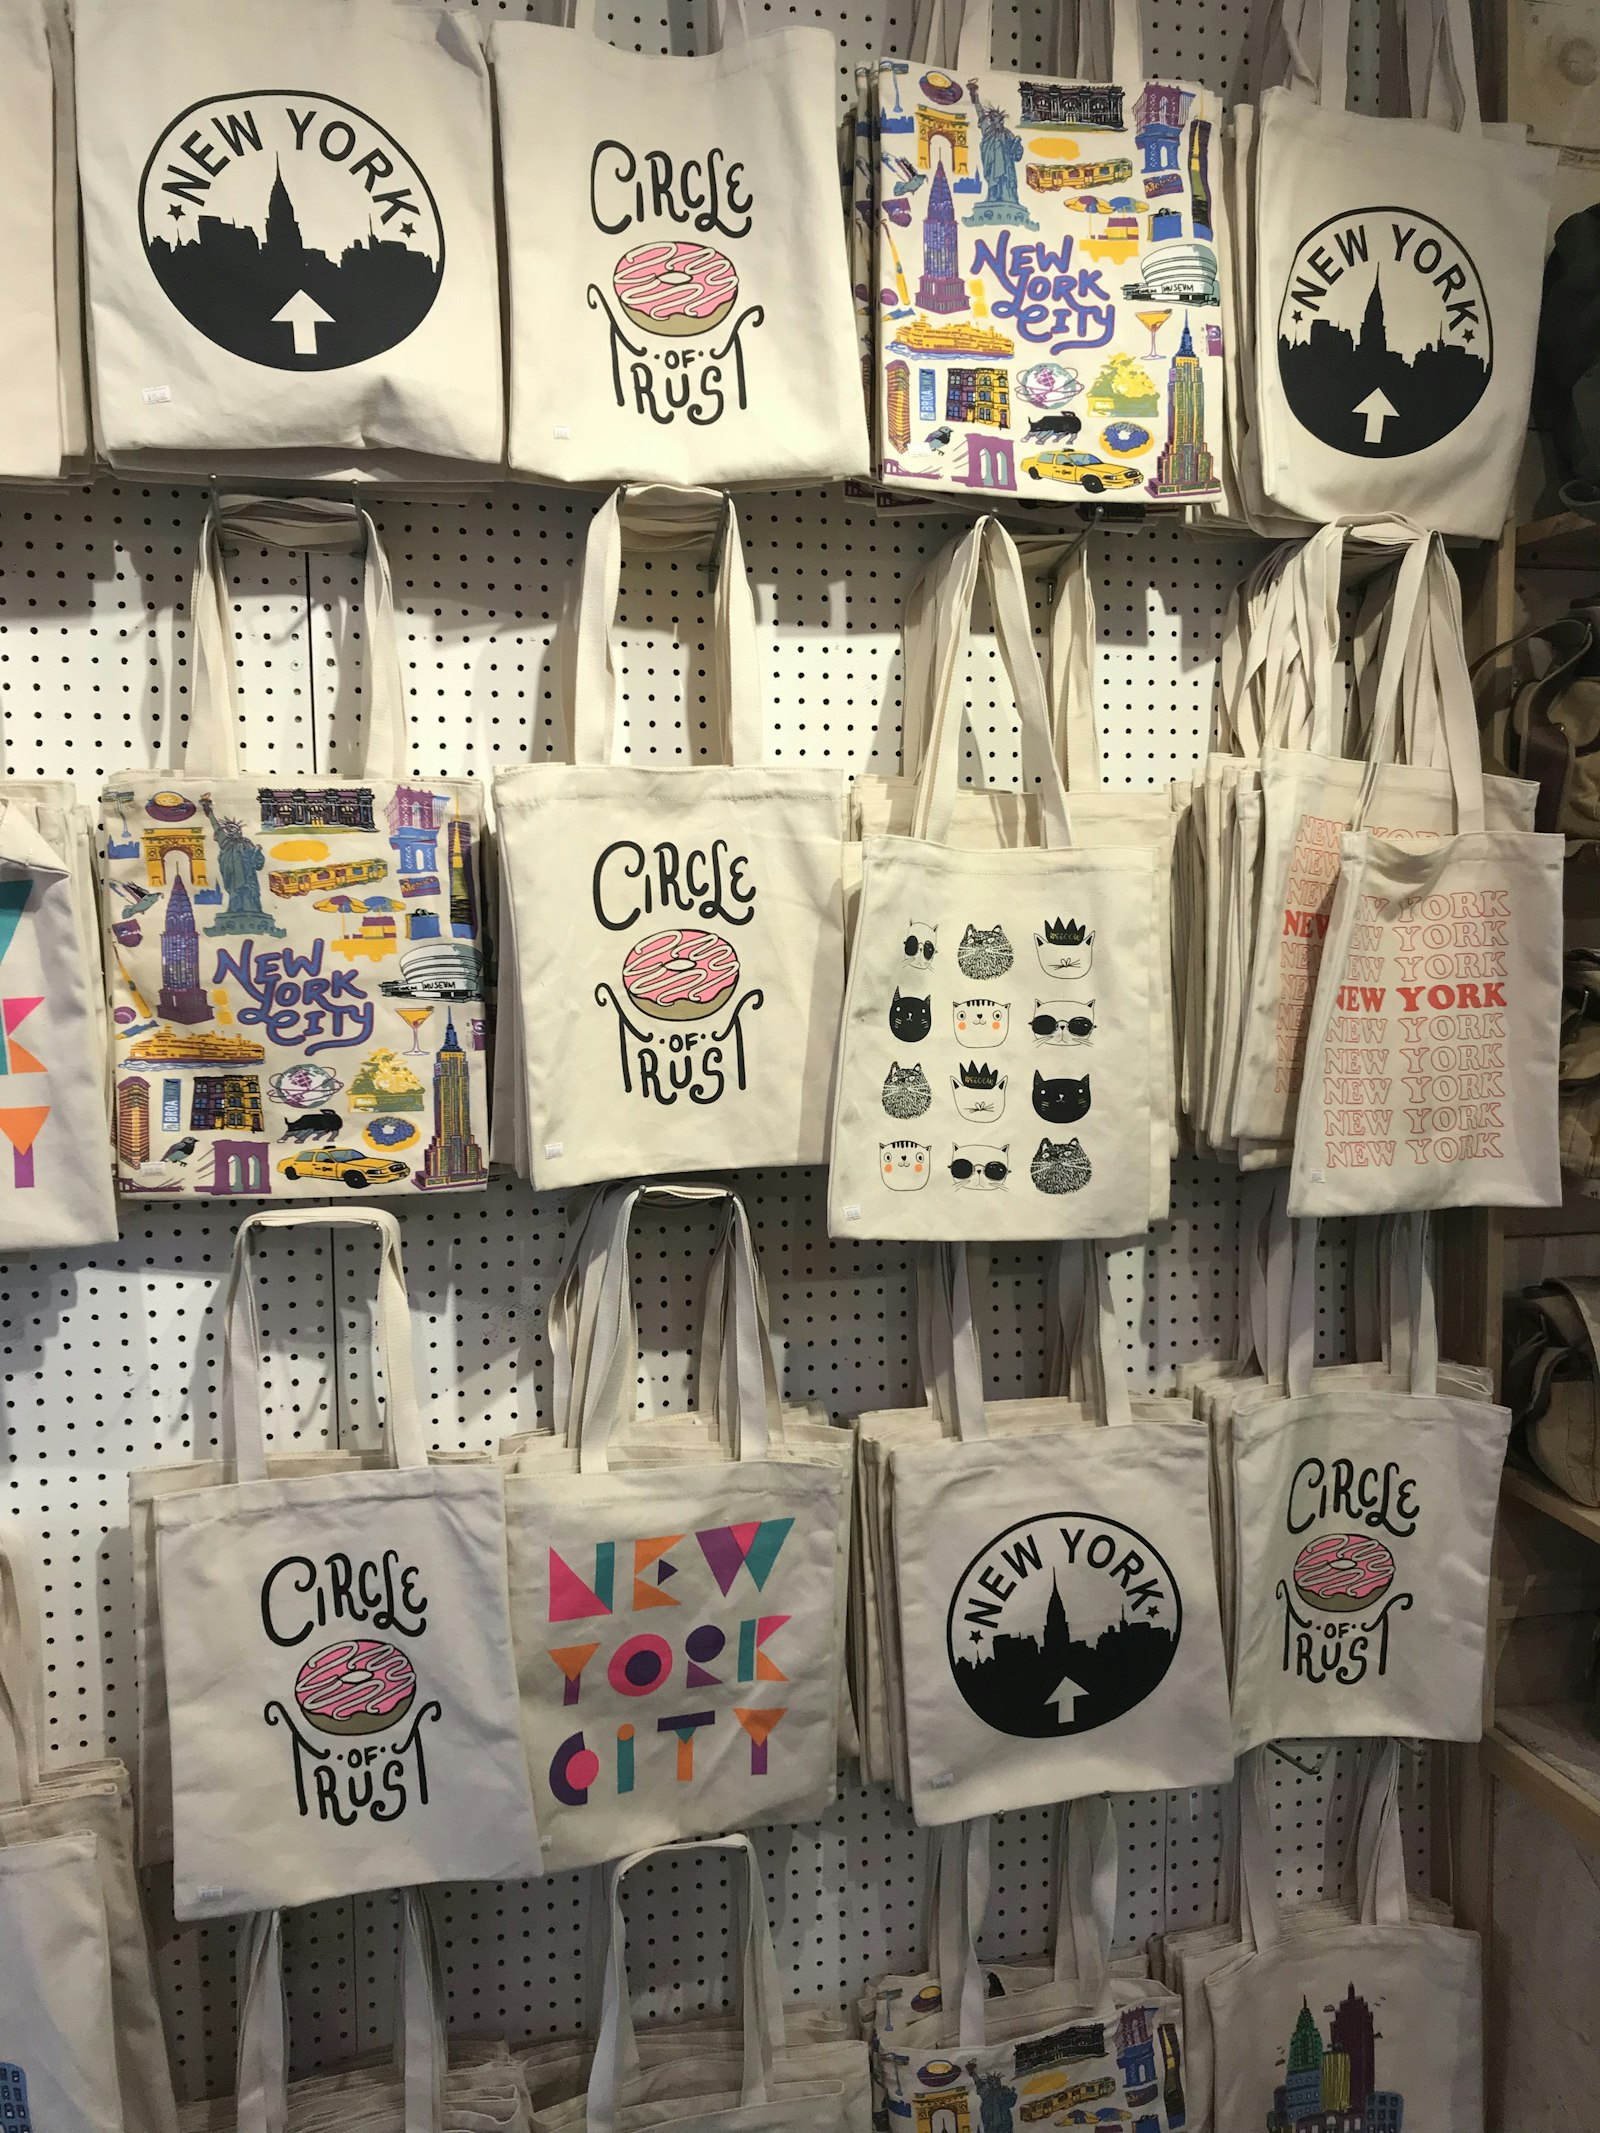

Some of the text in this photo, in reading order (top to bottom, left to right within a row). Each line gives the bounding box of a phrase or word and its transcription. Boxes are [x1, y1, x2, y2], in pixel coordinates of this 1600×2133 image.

[161, 108, 422, 224] NEW YORK
[970, 230, 1073, 295] NEW
[1294, 224, 1480, 331] NEW YORK
[991, 267, 1110, 318] YORK
[587, 284, 764, 425] TRUST
[1016, 304, 1115, 356] CITY
[1397, 891, 1511, 922] YORK
[1392, 921, 1508, 951] YORK
[212, 938, 324, 1001] NEW
[1346, 952, 1507, 982] EW YORK
[237, 969, 368, 1025] YORK
[1396, 982, 1507, 1012] YORK
[266, 1001, 374, 1057] CITY
[594, 982, 763, 1105] TRUST
[1325, 1013, 1505, 1044] NEW YORK
[1324, 1043, 1505, 1075] NEW YORK
[1323, 1071, 1505, 1105] NEW YORK
[1324, 1102, 1504, 1136] NEW YORK
[1325, 1133, 1504, 1168] NEW YORK
[548, 1517, 796, 1623] NEW
[964, 1528, 1164, 1628] NEW YORK
[1275, 1579, 1413, 1685] TRUST
[547, 1615, 792, 1706] YORK
[264, 1701, 441, 1826] TRUST
